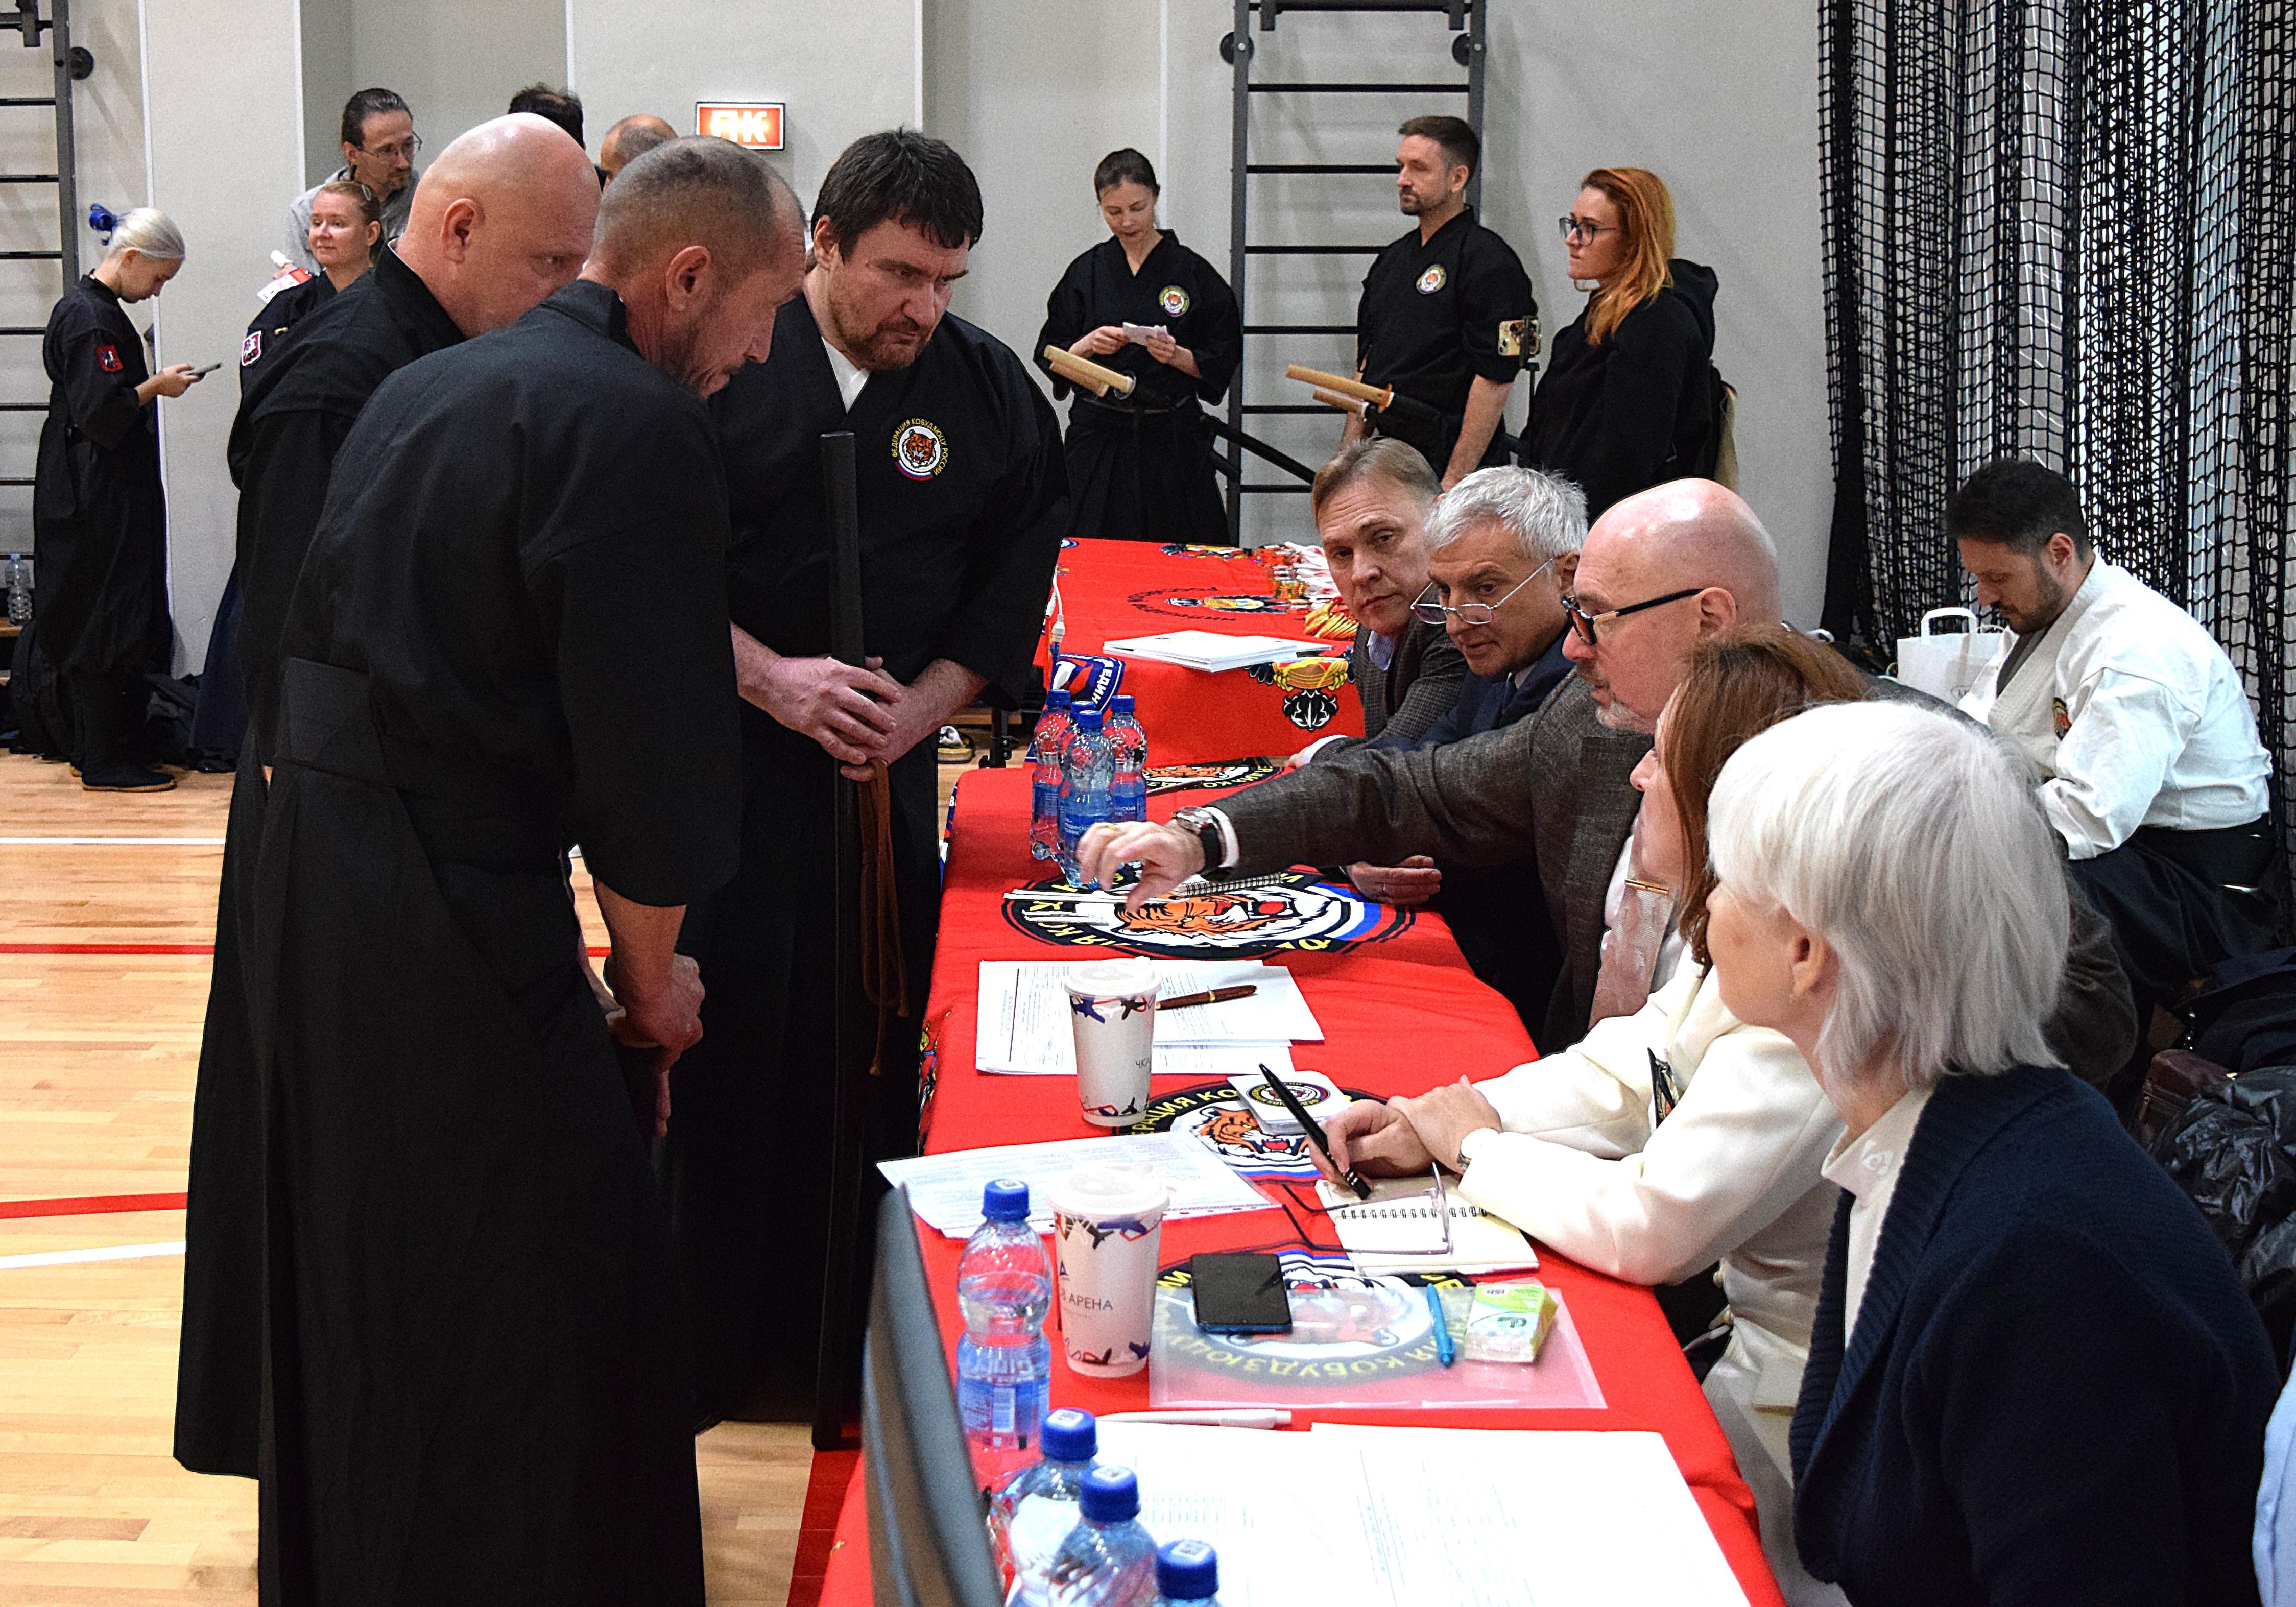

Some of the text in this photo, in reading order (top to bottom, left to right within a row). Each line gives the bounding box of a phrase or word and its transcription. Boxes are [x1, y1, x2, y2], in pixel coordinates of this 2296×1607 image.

[891, 418, 948, 475] ФЕДЕРАЦИЯ КОБУДЗЮЦУ РОССИИ
[1091, 668, 1113, 705] ЕДИН
[1131, 1096, 1197, 1135] РАЦИЯ
[1068, 1293, 1113, 1310] АРЕНА
